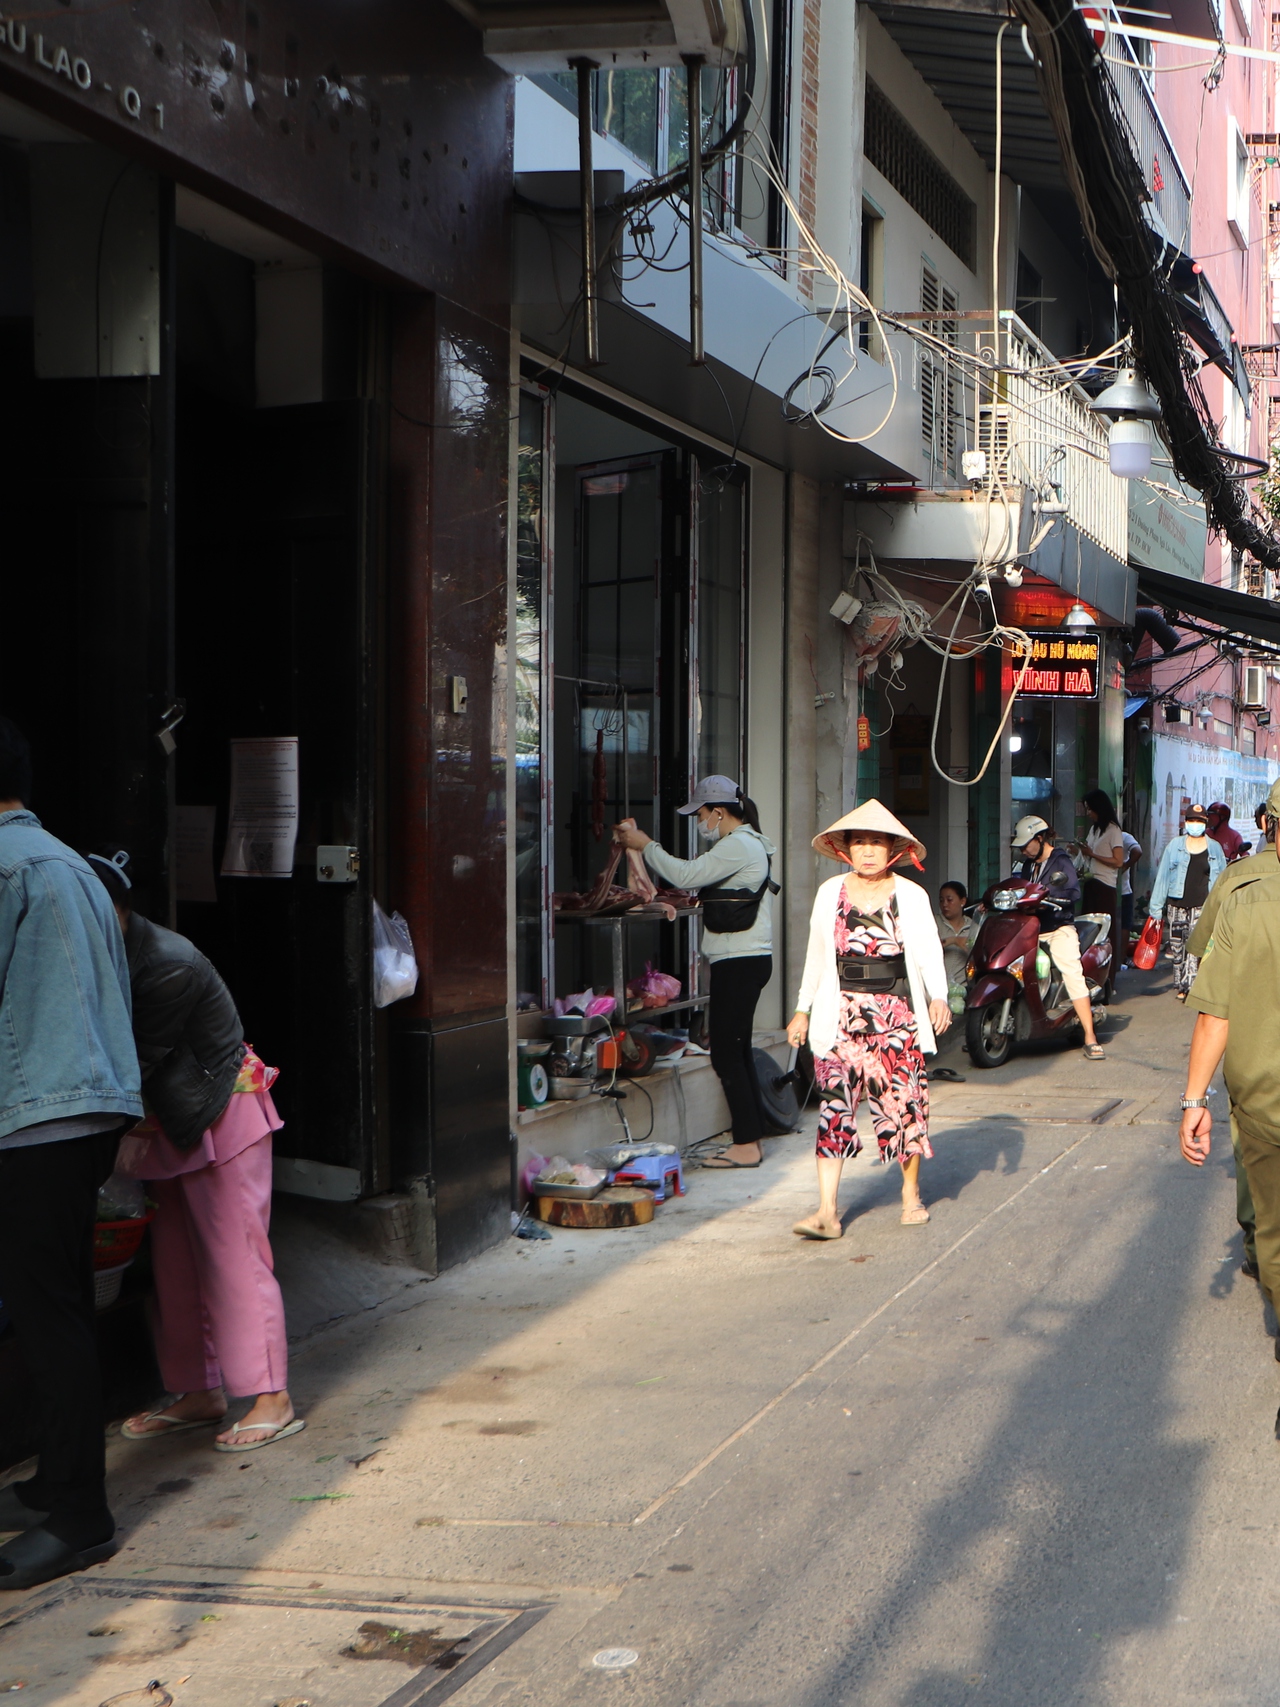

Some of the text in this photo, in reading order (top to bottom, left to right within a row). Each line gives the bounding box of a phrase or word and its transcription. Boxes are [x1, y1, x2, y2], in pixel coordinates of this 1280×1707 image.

[0, 11, 26, 53] U
[34, 34, 91, 90] LAO
[1026, 640, 1048, 661] ẬU
[1050, 641, 1065, 659] HŨ
[1067, 641, 1097, 660] NÓNG
[1013, 667, 1092, 692] VĨNH HÀ
